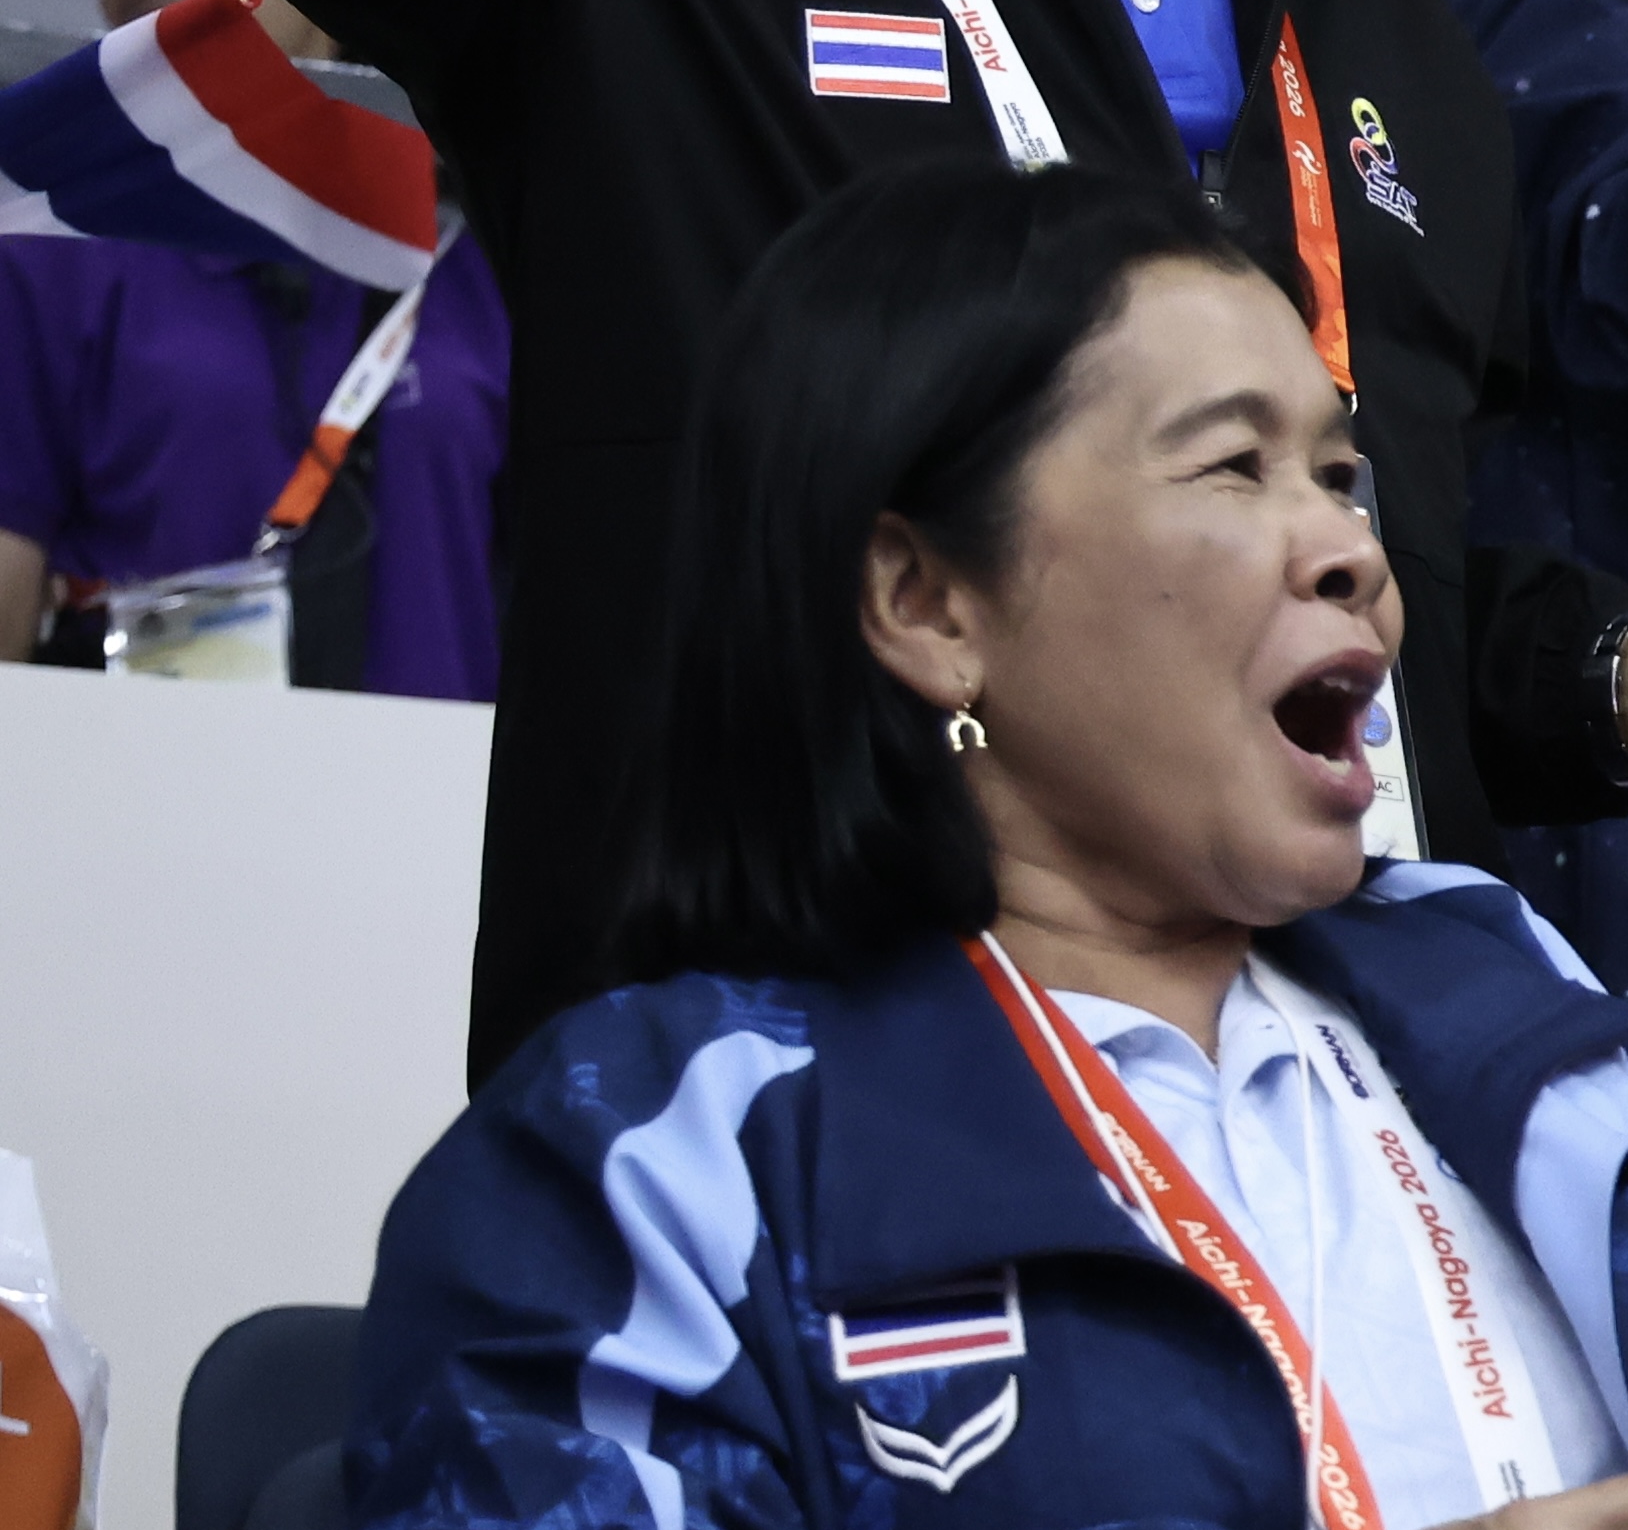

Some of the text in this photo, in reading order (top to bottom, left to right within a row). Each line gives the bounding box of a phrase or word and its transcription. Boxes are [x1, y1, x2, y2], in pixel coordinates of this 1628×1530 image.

[1278, 54, 1306, 118] 2026
[1374, 1129, 1513, 1420] Aichi-Nagoya 2026
